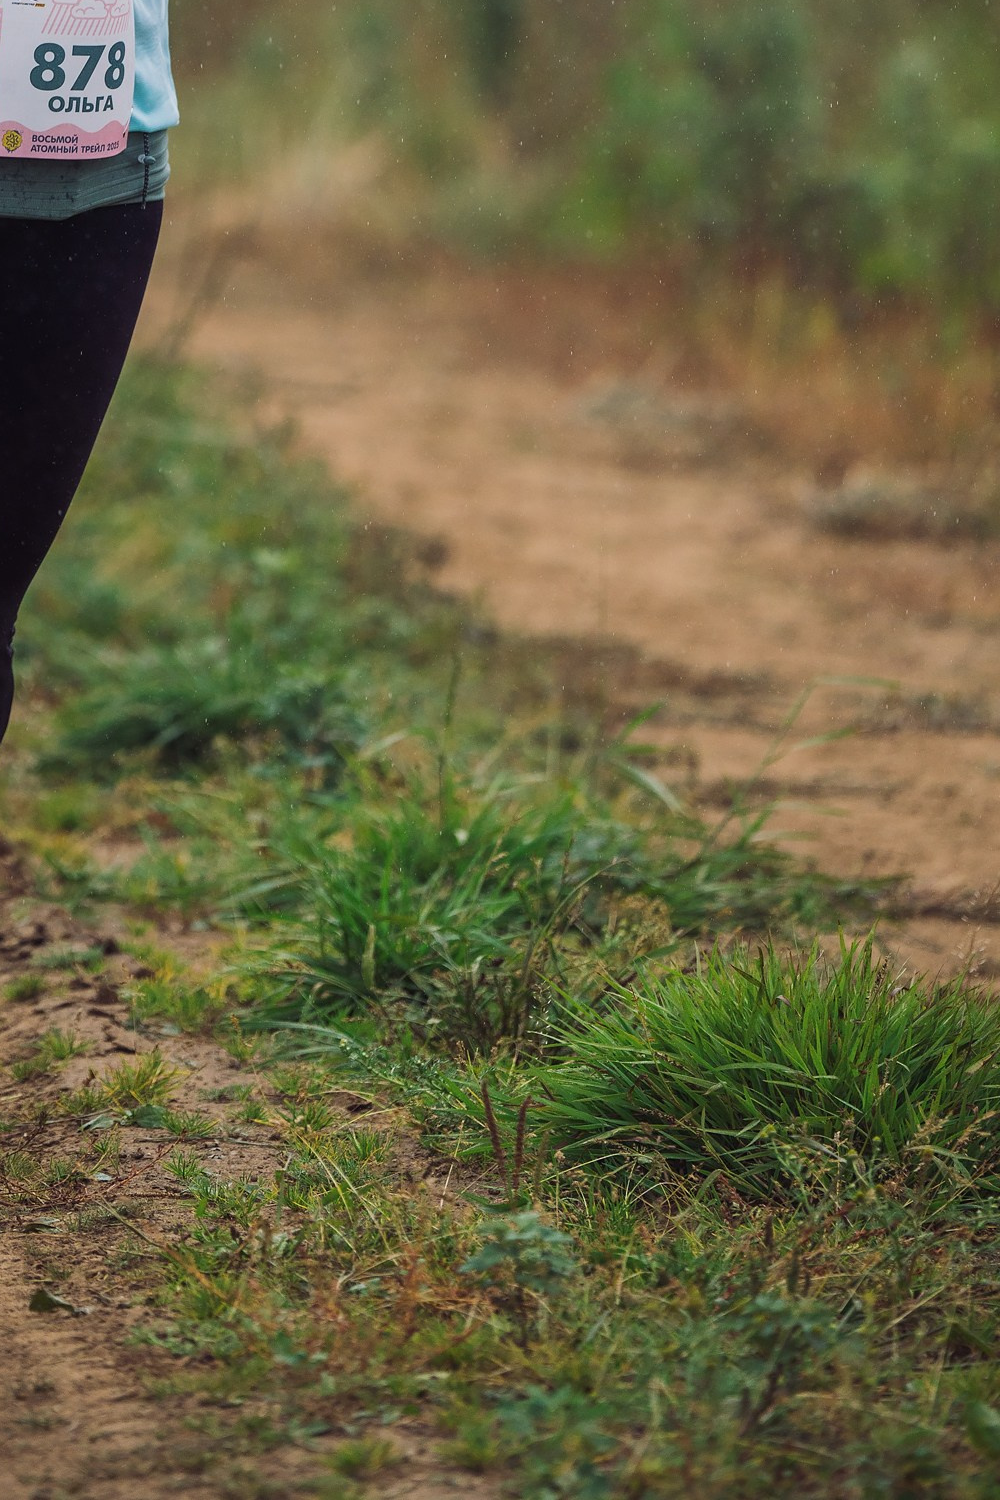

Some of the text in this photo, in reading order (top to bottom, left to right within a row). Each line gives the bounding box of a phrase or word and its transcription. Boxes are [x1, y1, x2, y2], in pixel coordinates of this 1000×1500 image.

[29, 41, 126, 91] 878
[48, 95, 114, 113] ОЛЬГА
[32, 134, 79, 144] ВОСЬМОЙ
[30, 144, 78, 153] АТОМНЫЙ
[81, 143, 105, 153] ТРЕЙЛ
